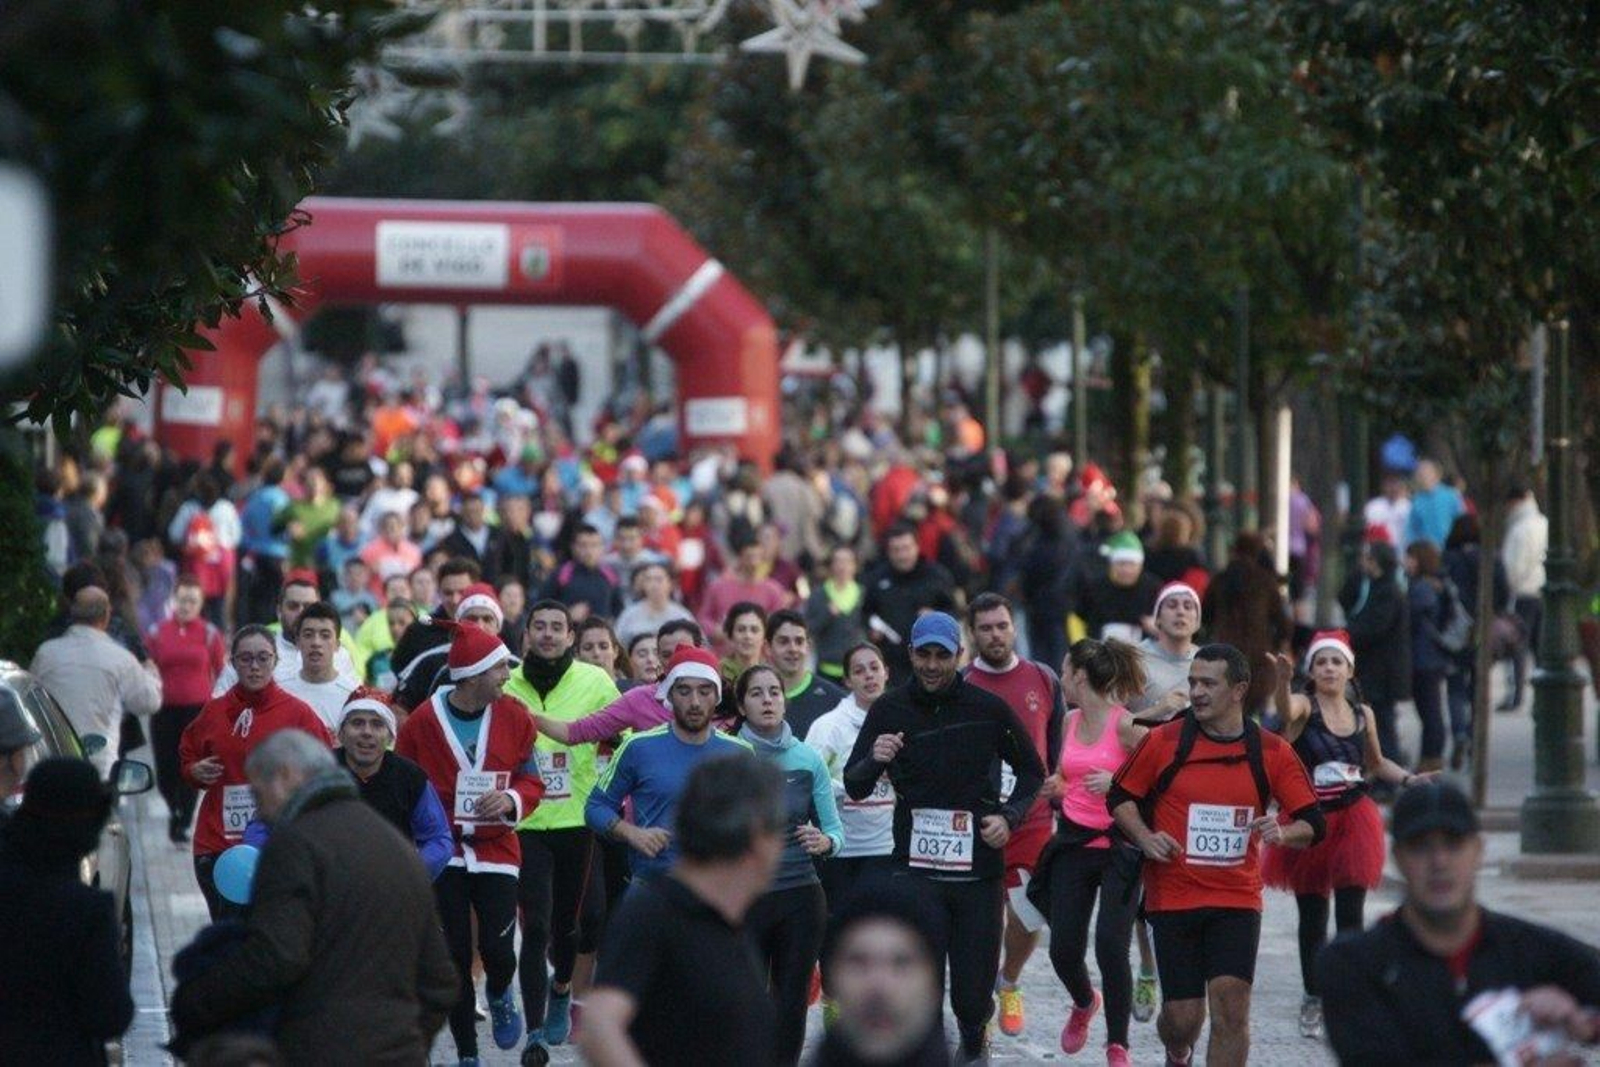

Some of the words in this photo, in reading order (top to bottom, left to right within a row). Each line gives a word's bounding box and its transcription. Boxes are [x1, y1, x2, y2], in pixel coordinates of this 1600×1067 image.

[398, 257, 424, 274] DE
[917, 837, 964, 857] 0374
[1195, 834, 1243, 853] 0314
